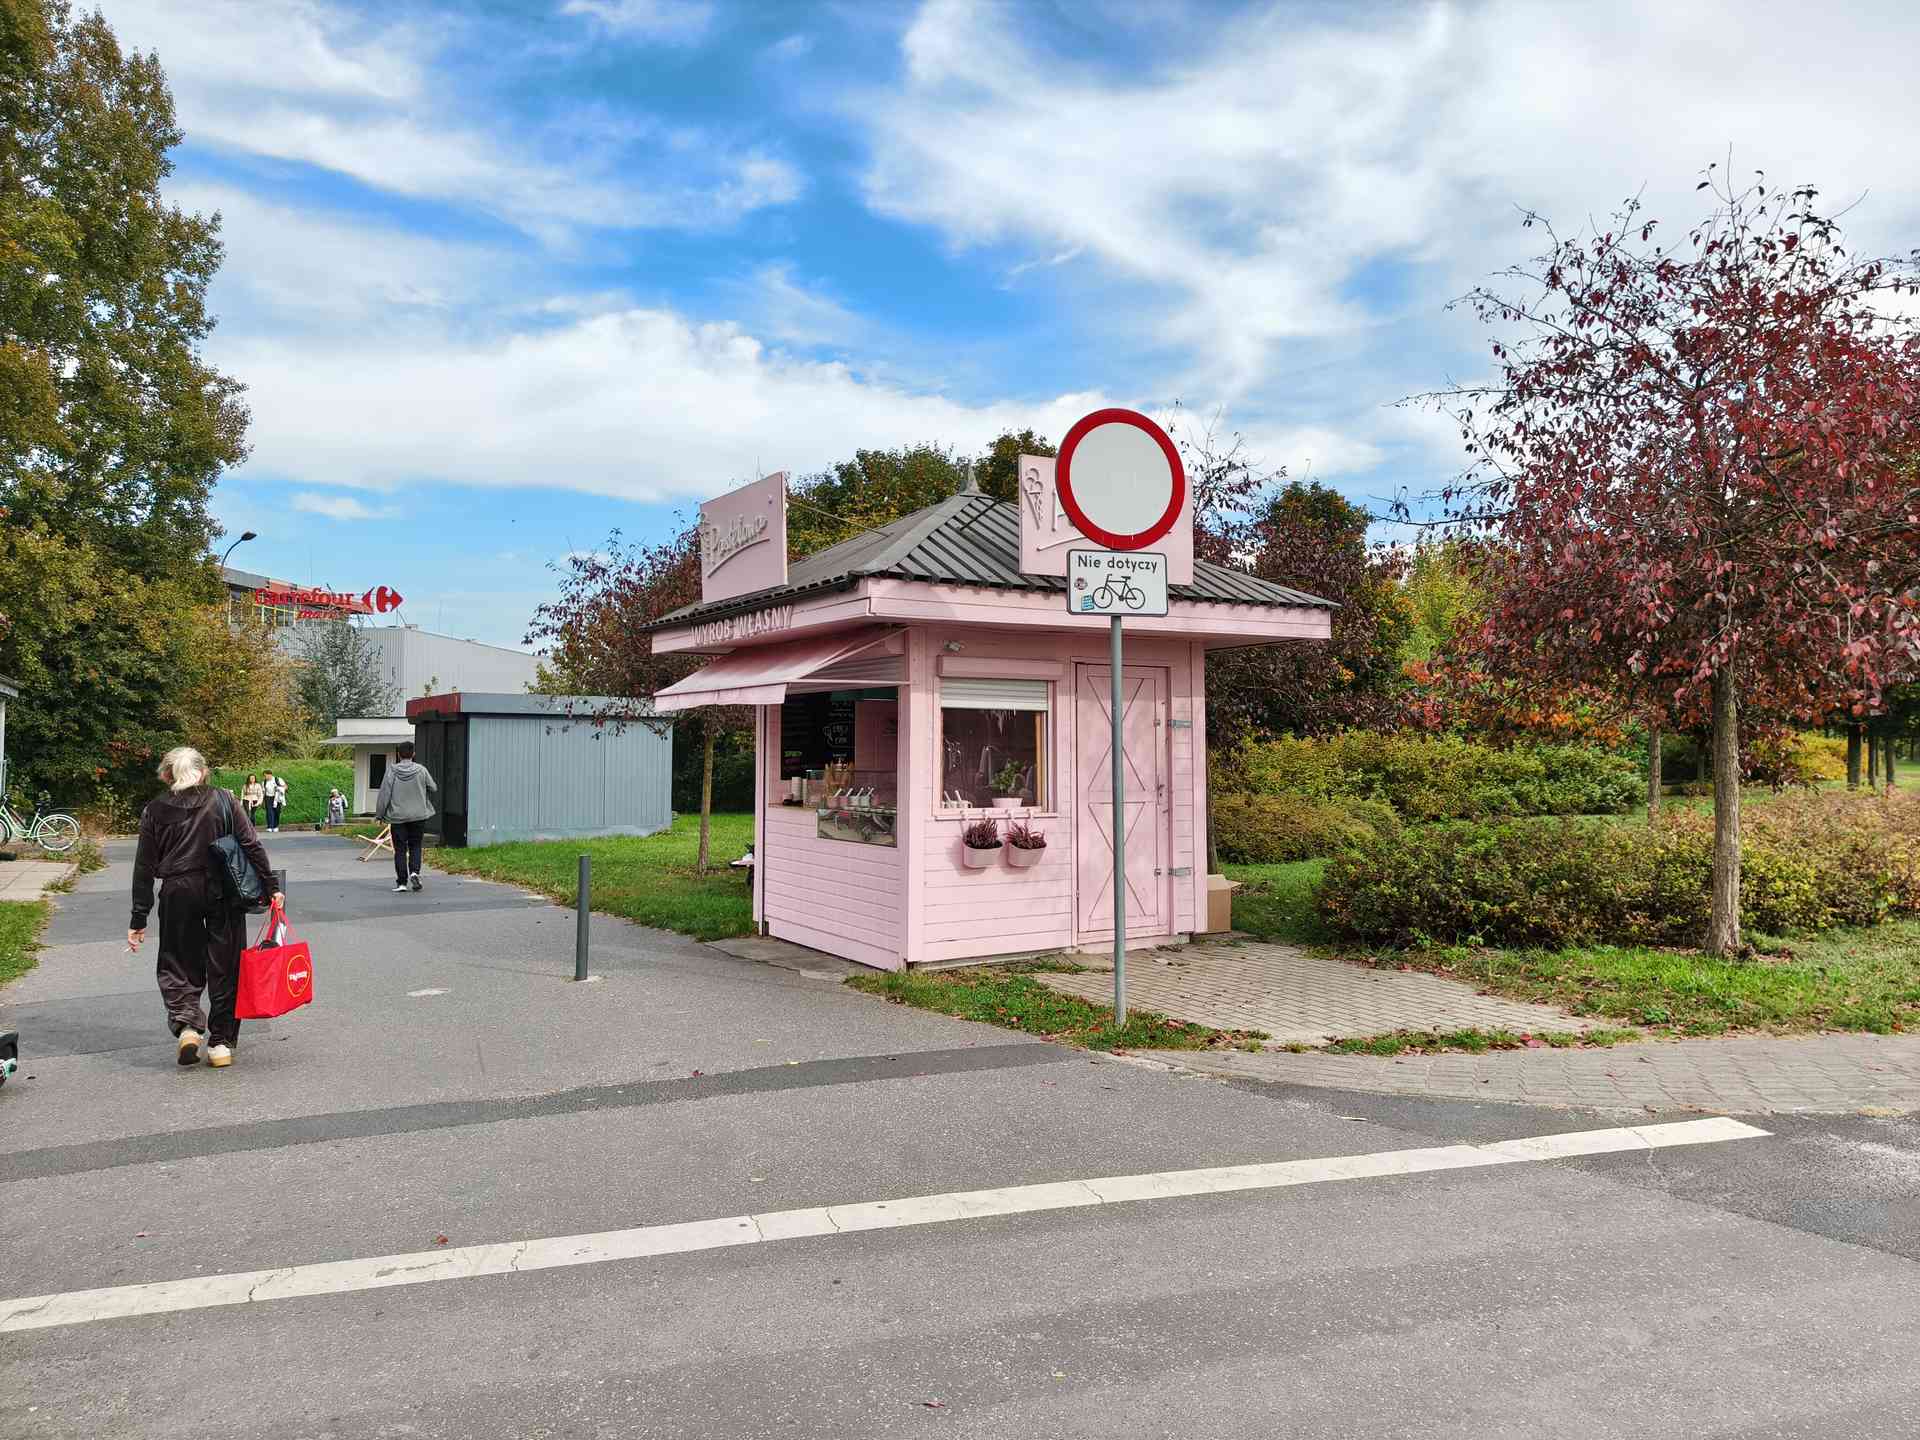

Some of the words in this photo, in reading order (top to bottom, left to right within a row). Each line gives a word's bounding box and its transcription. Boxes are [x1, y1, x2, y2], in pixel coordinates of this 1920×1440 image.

[1077, 554, 1102, 569] Nie
[1107, 556, 1158, 574] dotyczy
[255, 587, 354, 607] Carrefour
